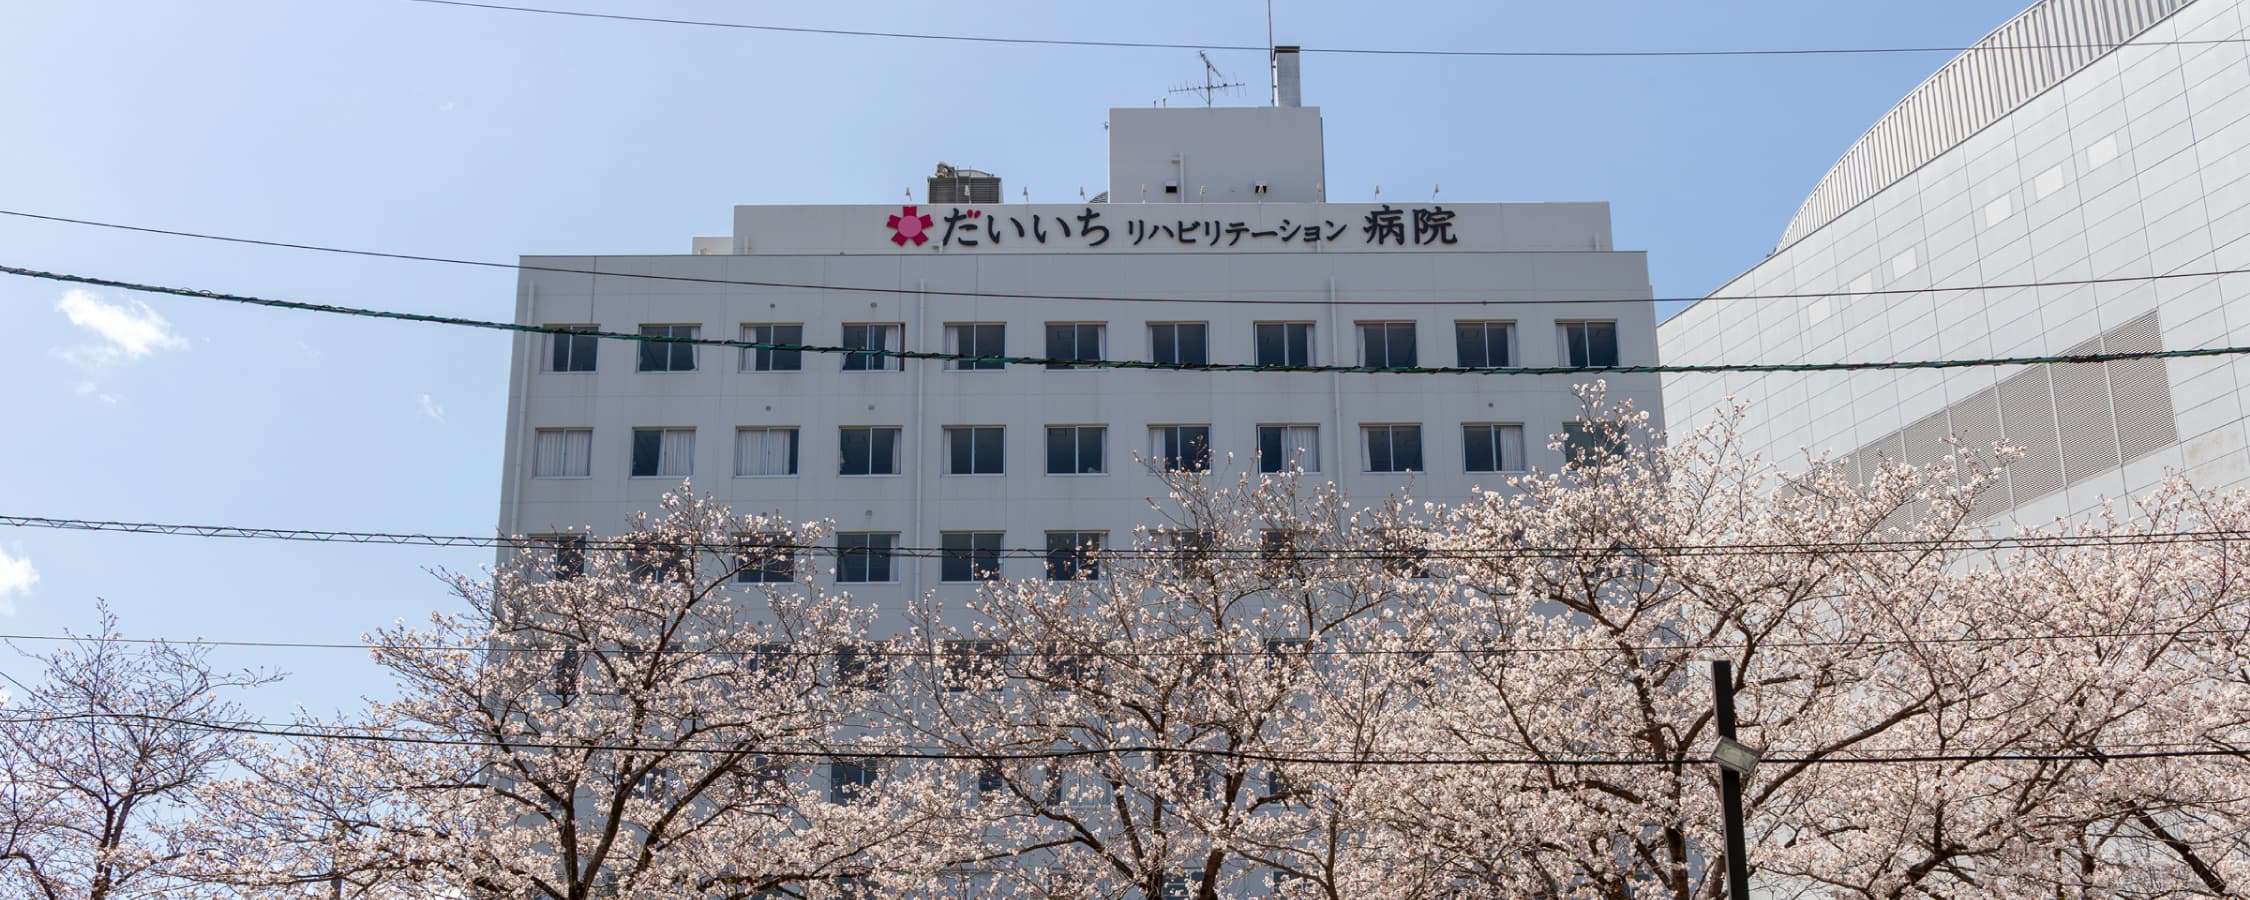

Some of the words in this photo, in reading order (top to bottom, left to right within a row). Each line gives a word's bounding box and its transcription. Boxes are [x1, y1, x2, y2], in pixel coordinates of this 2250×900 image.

[942, 207, 1110, 247] だいいち
[1127, 219, 1348, 246] リハビリテーション
[1362, 204, 1458, 246] 病院
